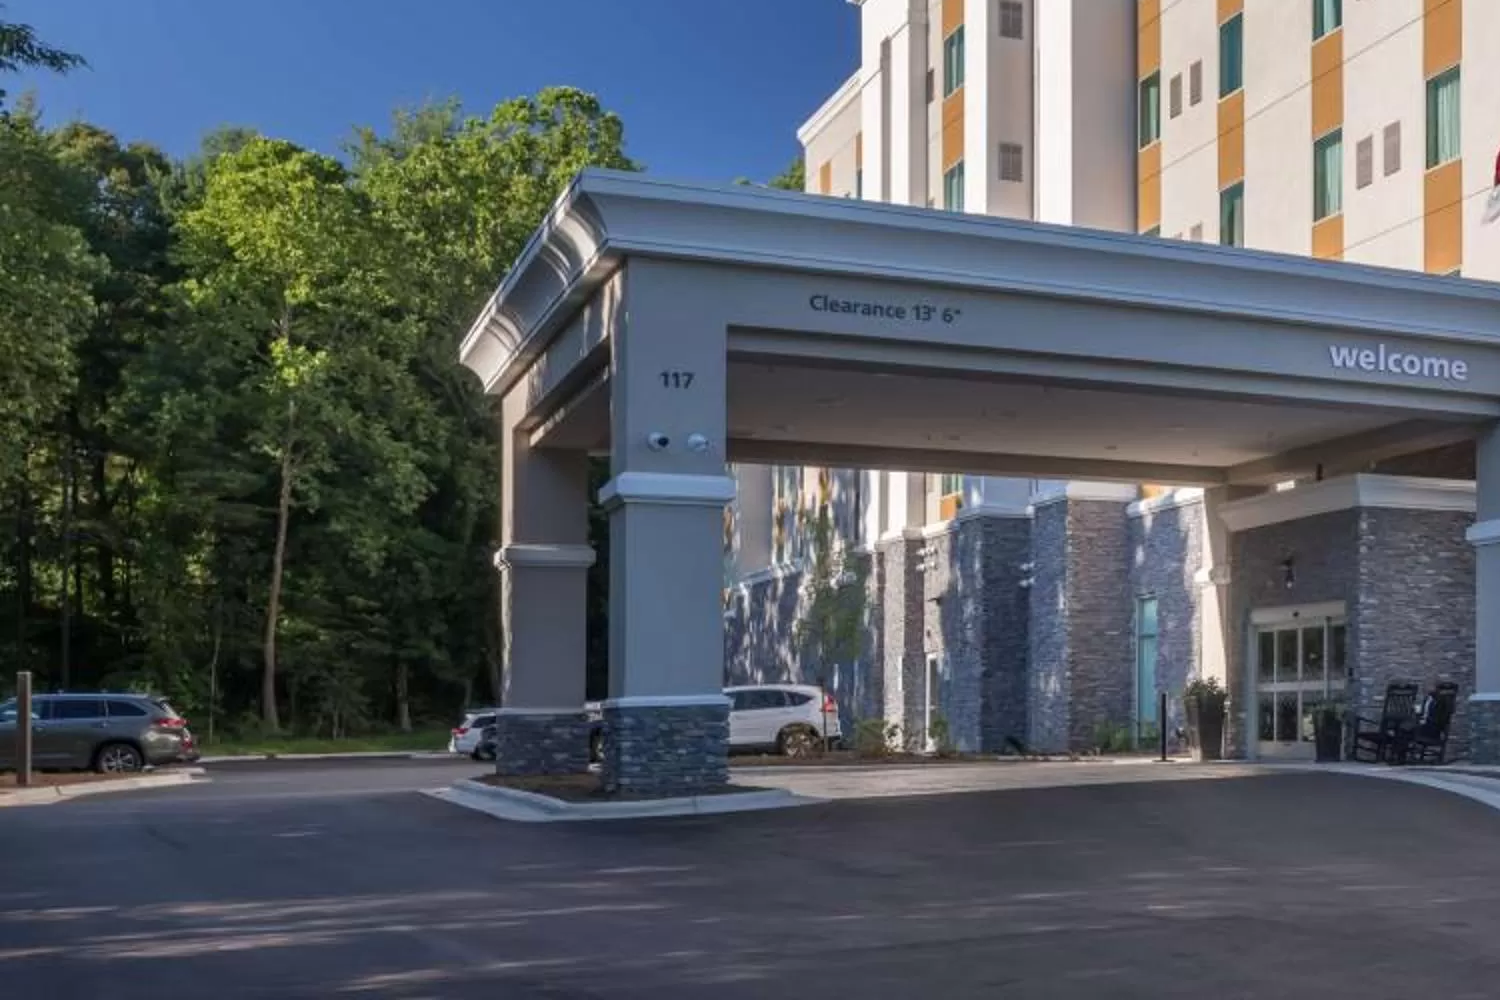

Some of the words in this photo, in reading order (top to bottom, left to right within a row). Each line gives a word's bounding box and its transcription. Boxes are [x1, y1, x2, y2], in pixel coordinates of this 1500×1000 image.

[810, 294, 905, 320] Clearance
[1330, 343, 1468, 380] welcome
[660, 371, 696, 390] 117
